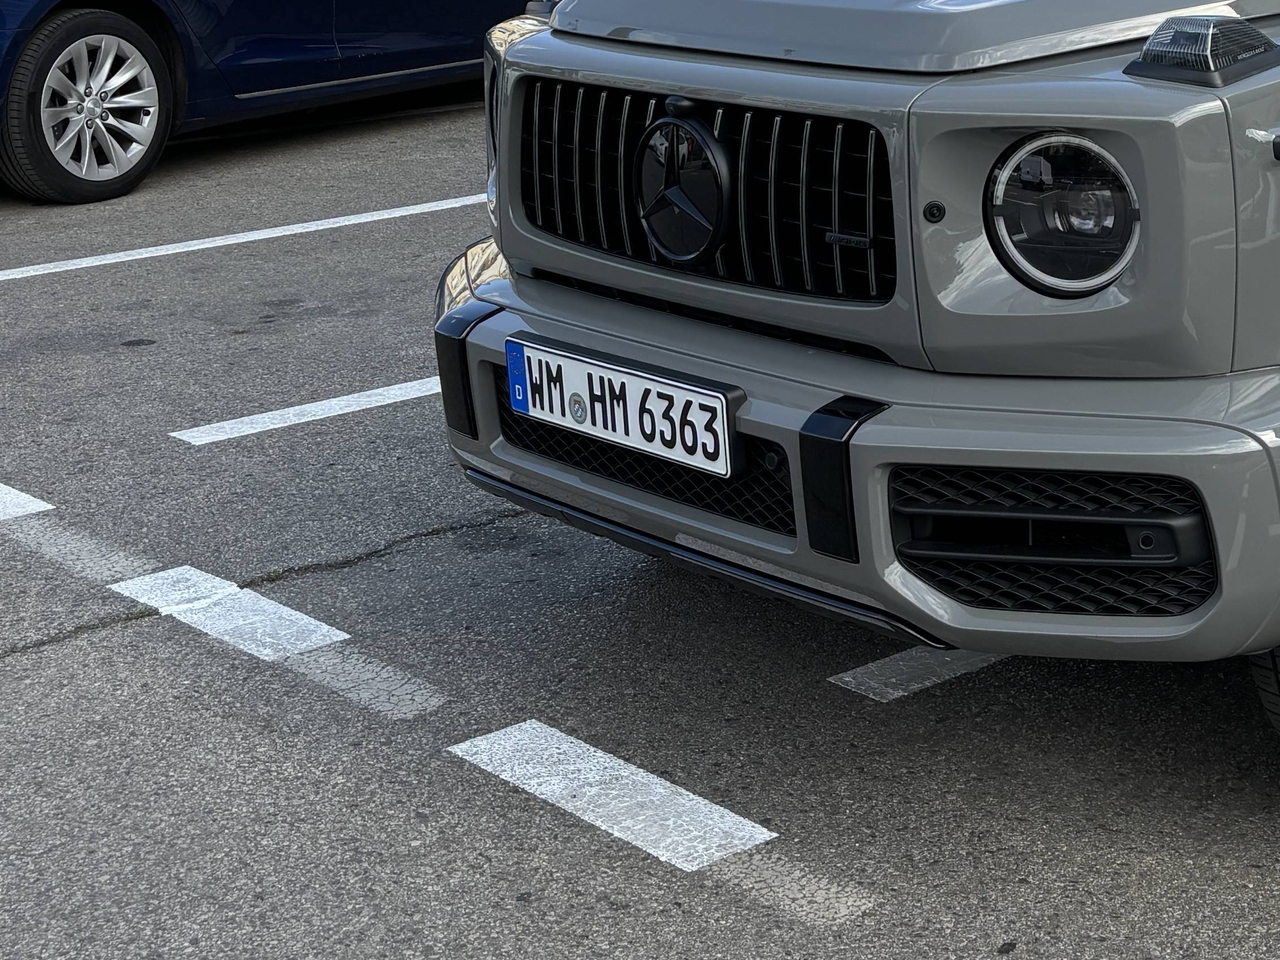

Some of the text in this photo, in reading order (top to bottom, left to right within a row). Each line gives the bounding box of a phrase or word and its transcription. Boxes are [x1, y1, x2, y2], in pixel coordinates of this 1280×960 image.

[515, 384, 523, 400] D
[527, 354, 720, 462] WM HM 6363
